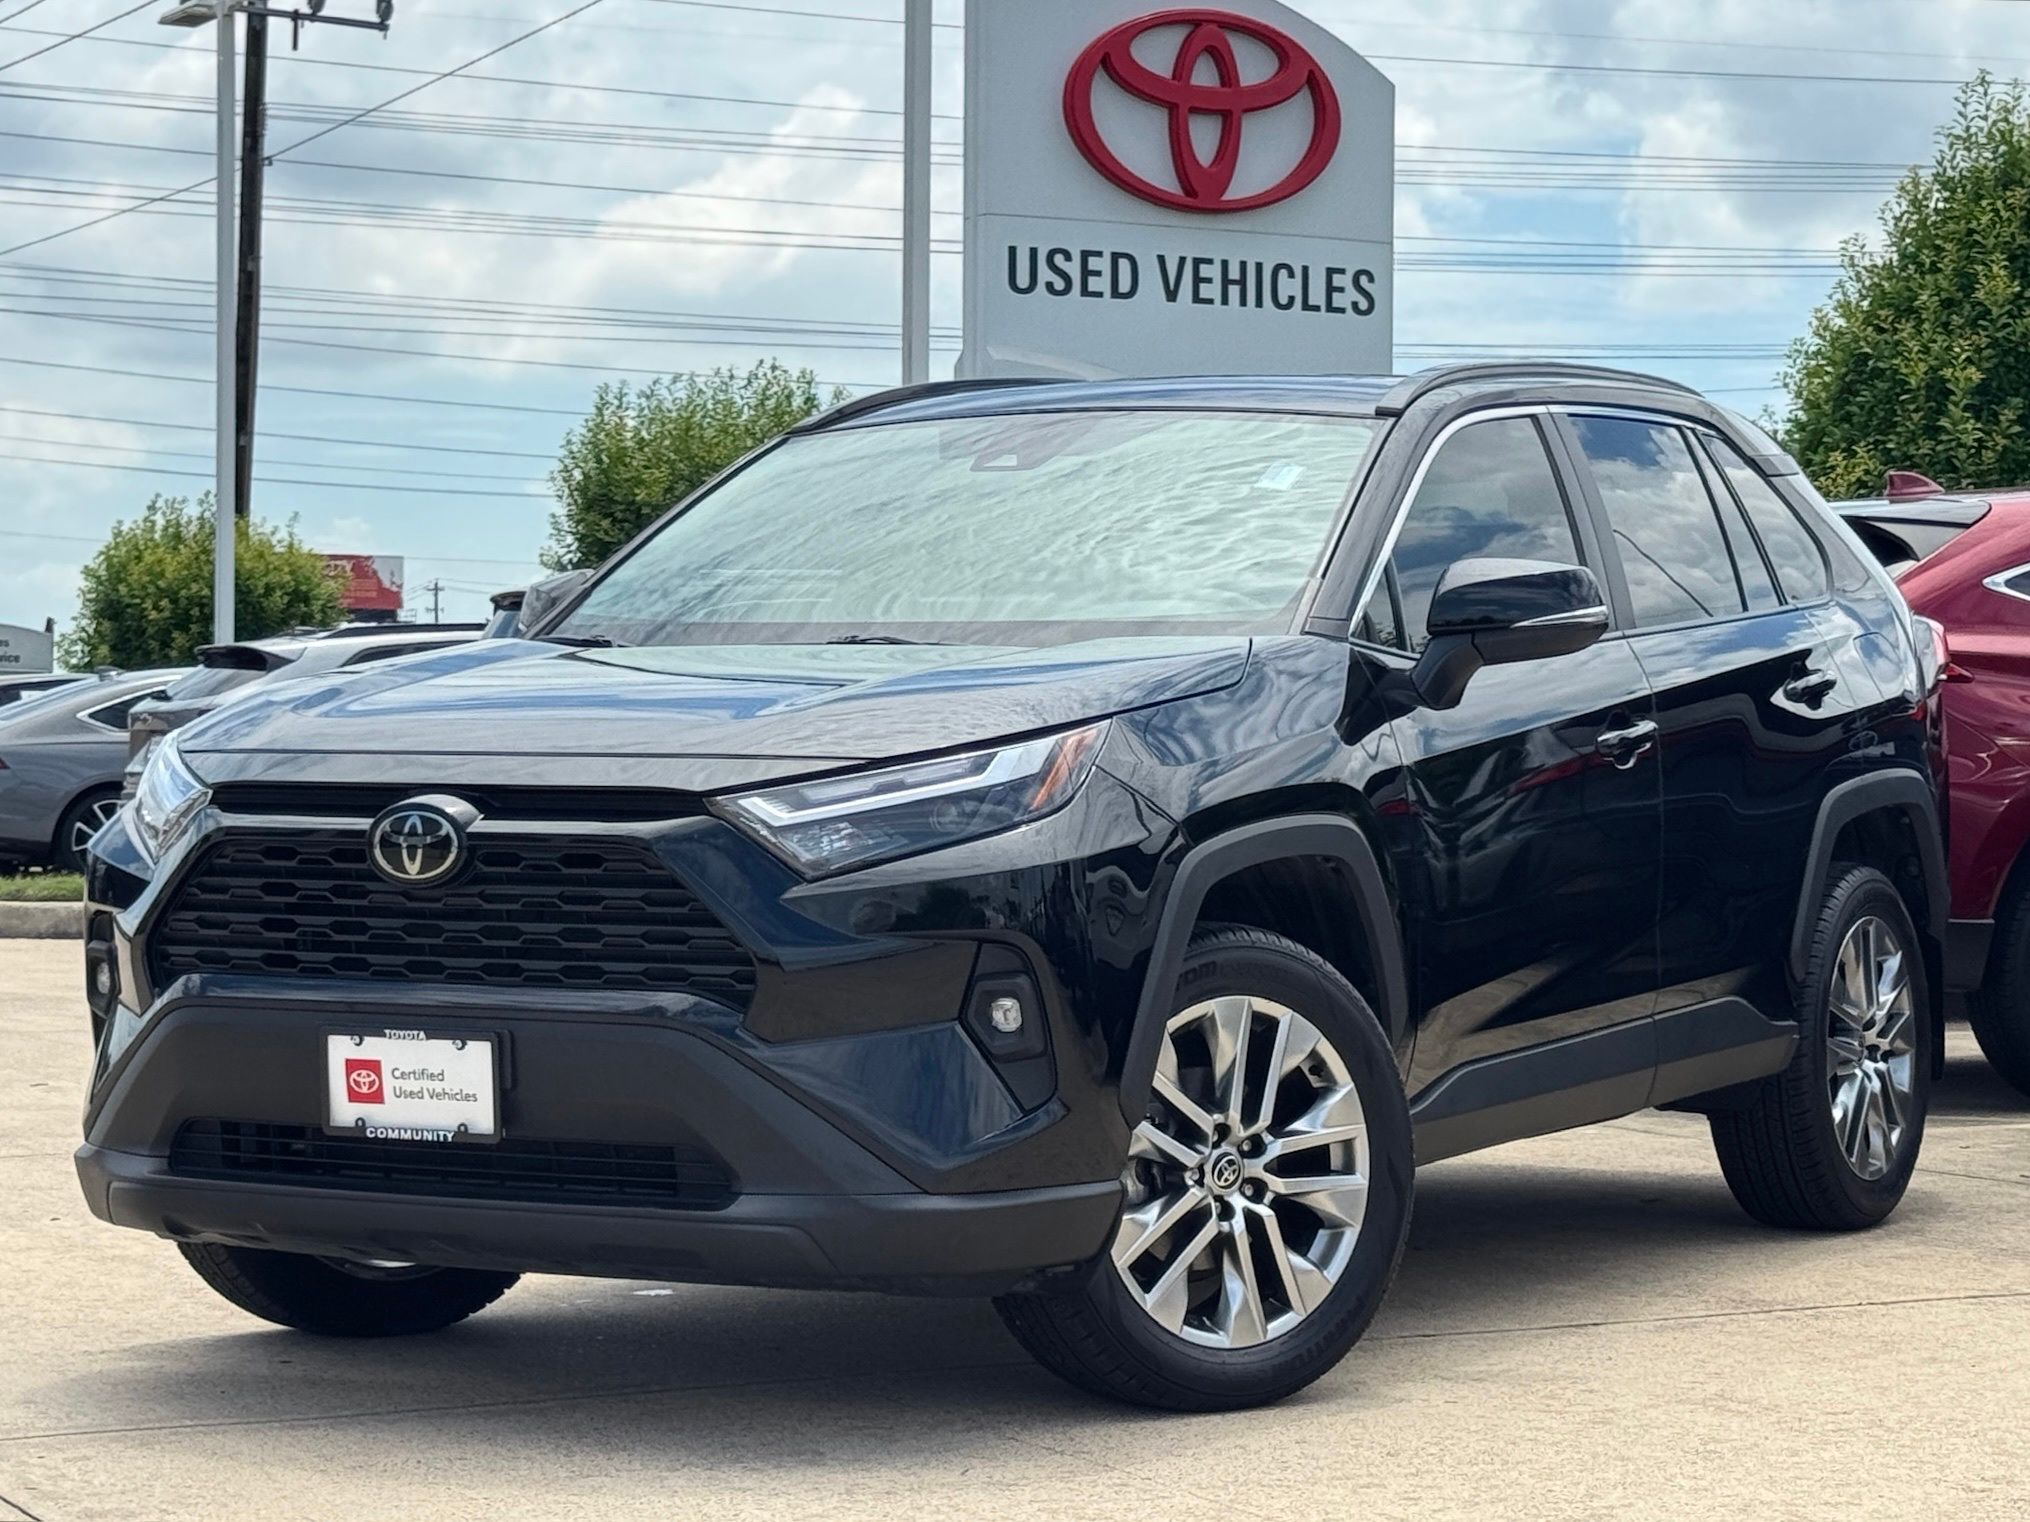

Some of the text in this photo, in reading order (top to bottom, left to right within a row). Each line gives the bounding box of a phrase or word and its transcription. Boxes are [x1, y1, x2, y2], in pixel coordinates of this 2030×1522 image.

[1007, 245, 1376, 317] USED VEHICLES
[383, 1029, 427, 1042] TOYOTA
[391, 1067, 445, 1082] Certified
[393, 1086, 478, 1103] Used Vehicles
[366, 1127, 455, 1142] COMMUNITY
